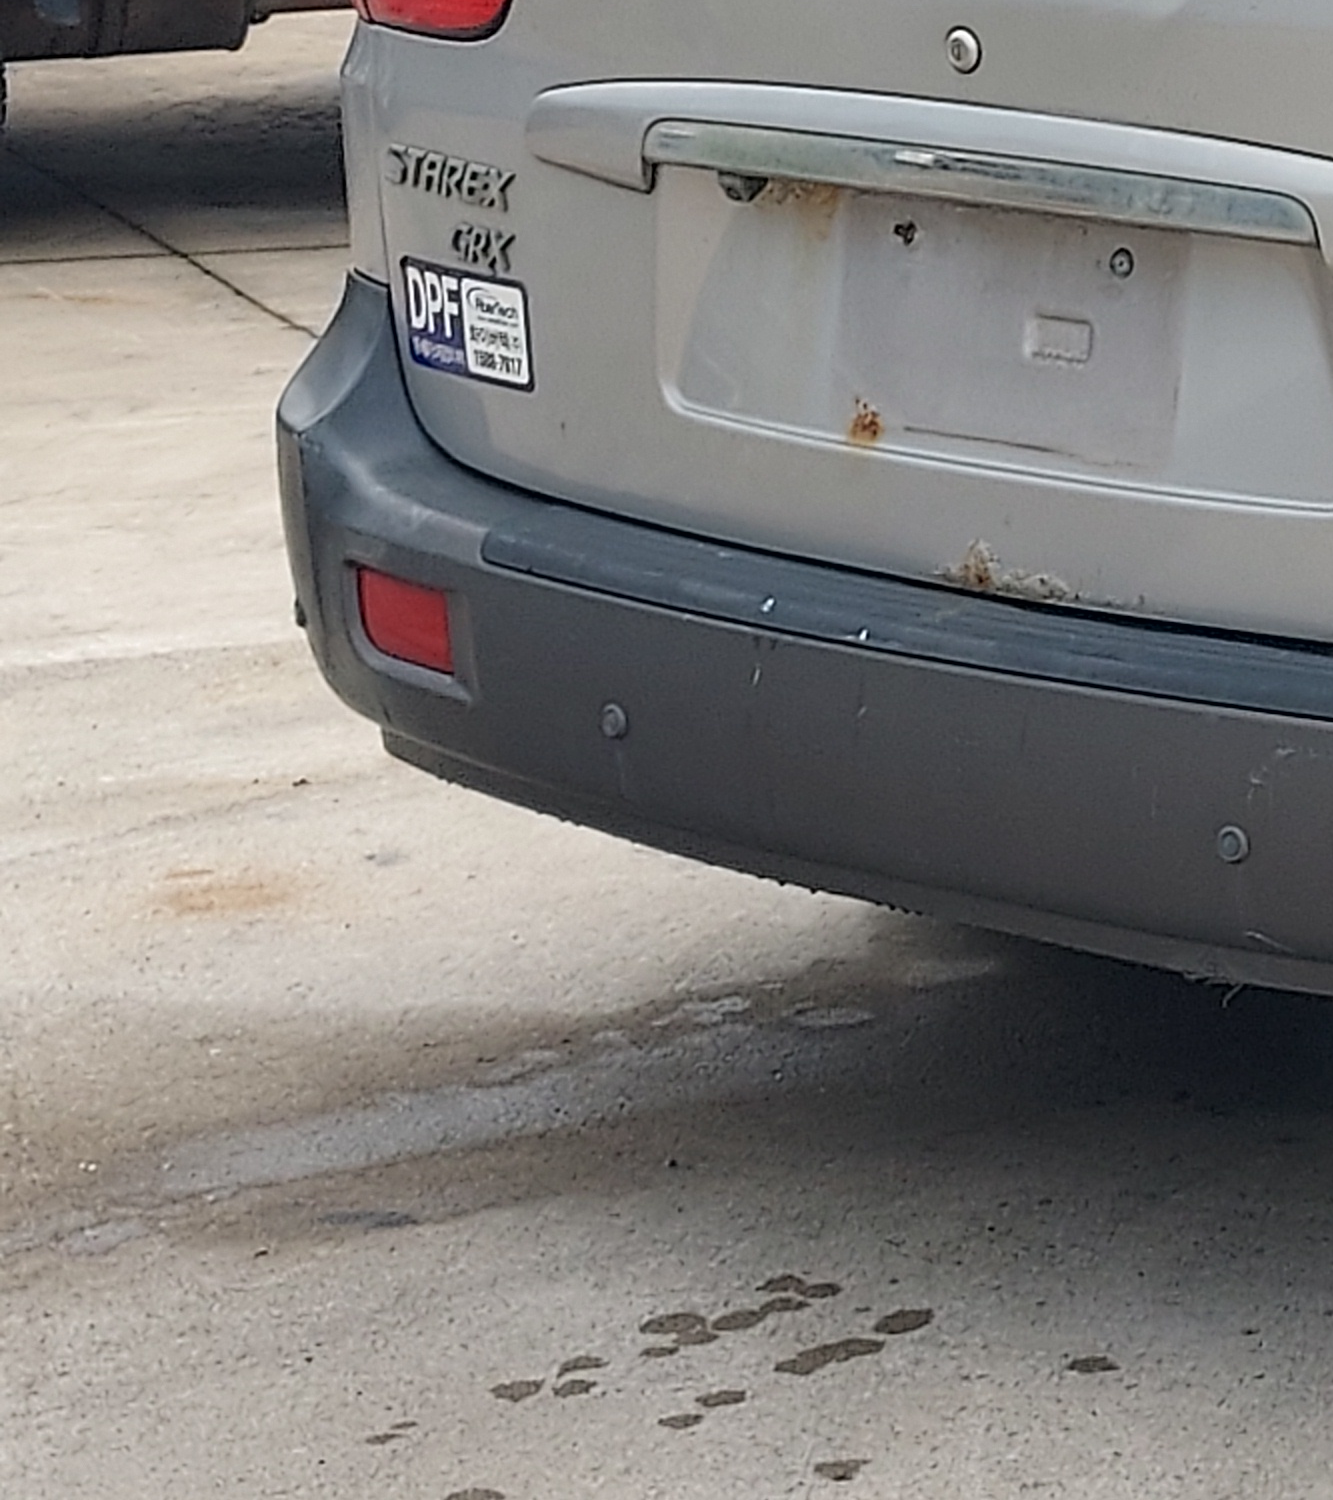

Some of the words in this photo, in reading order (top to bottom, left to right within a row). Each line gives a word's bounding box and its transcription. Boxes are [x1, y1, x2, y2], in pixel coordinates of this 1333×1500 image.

[385, 144, 516, 211] STAREX
[452, 221, 516, 272] GRX
[406, 265, 460, 339] DPF
